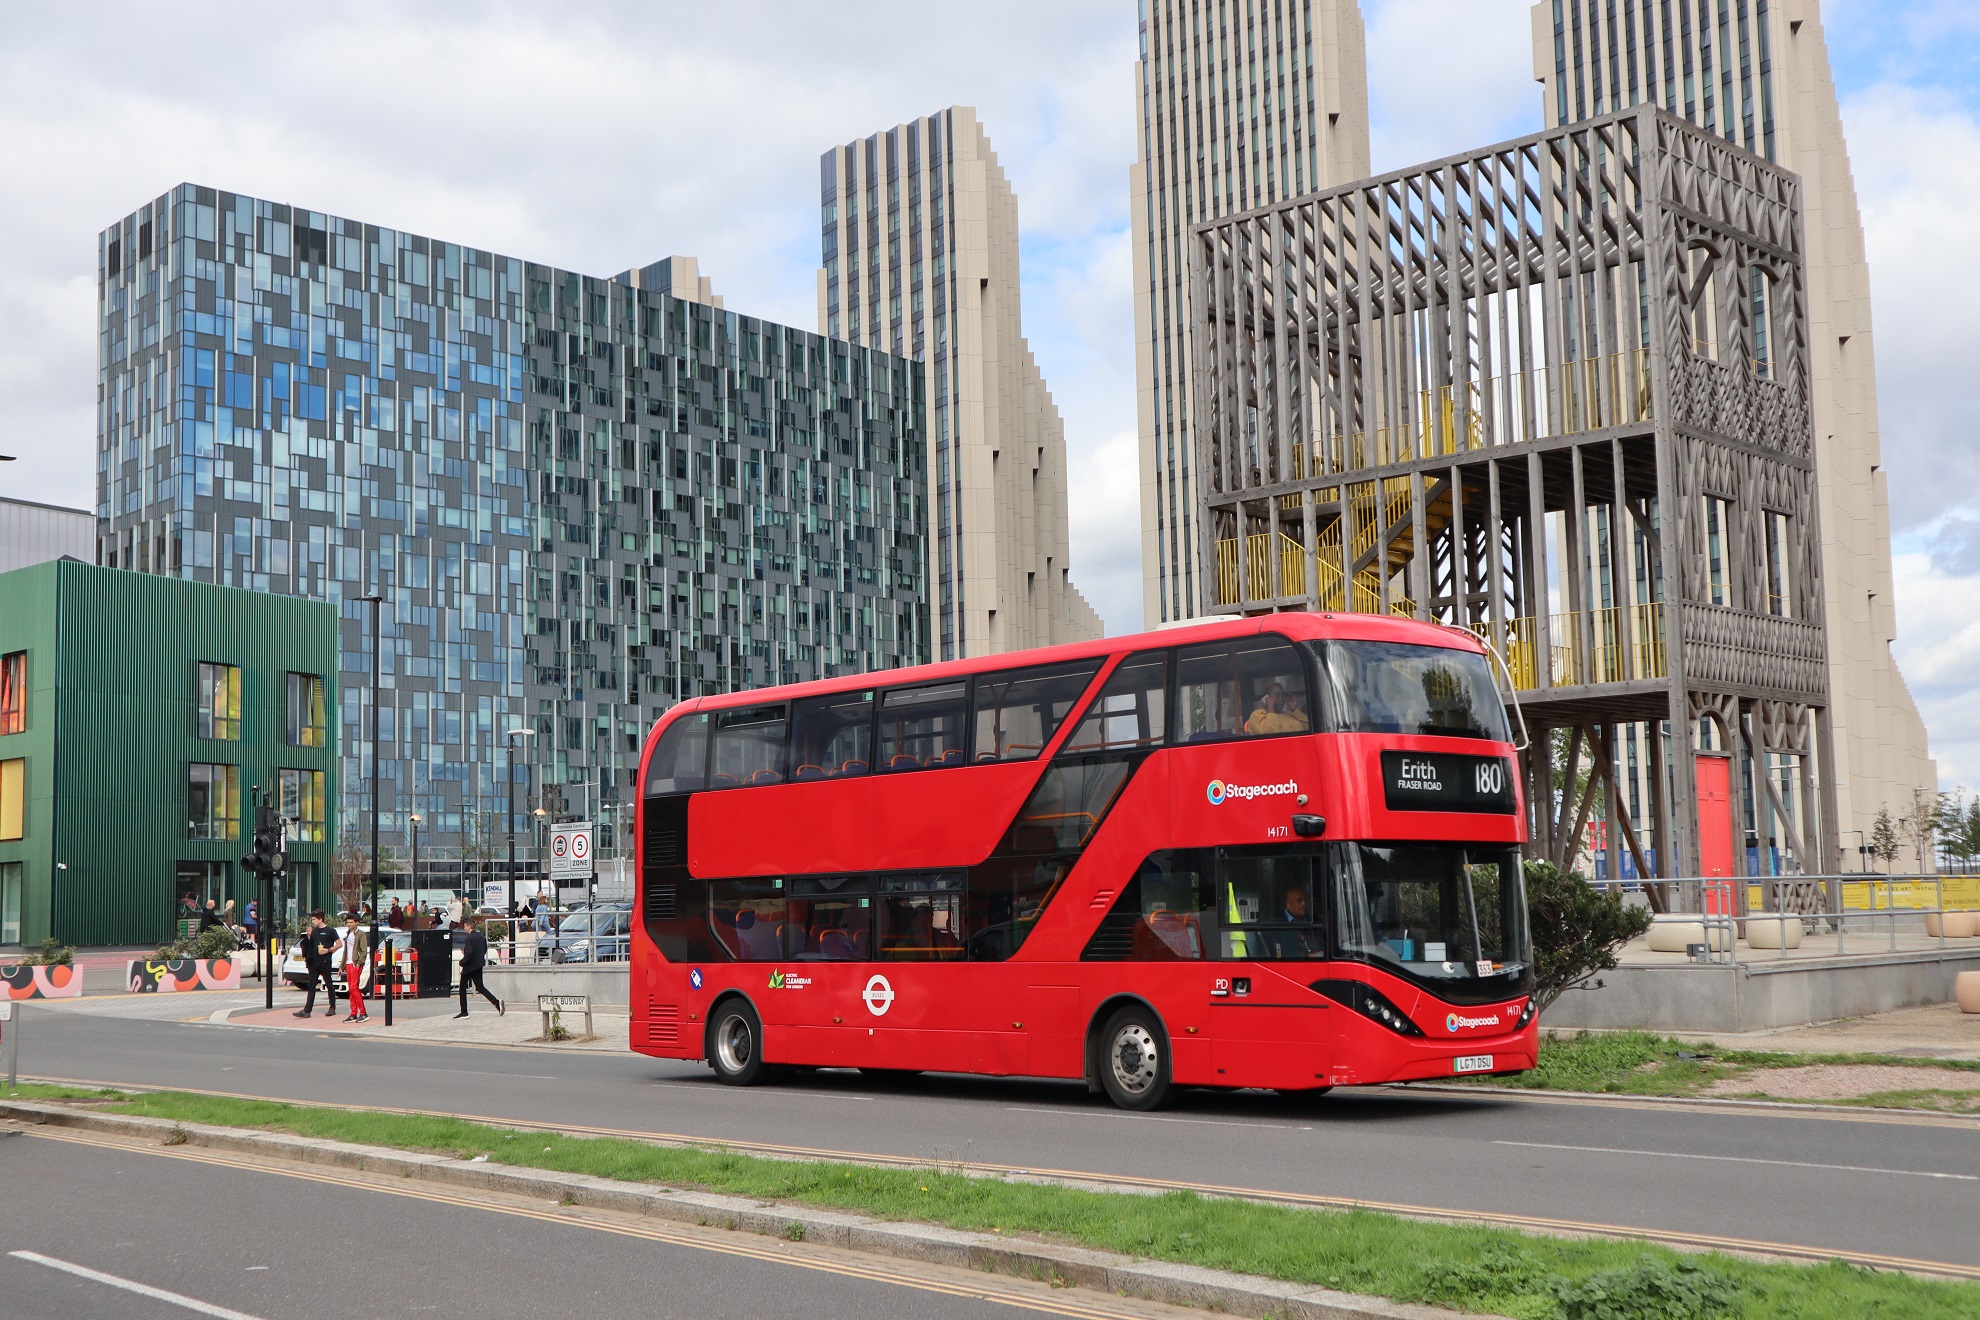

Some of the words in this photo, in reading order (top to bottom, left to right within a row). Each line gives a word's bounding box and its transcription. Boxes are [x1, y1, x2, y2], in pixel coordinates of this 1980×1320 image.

[1402, 758, 1436, 780] Erith
[1475, 763, 1502, 794] 180
[1226, 779, 1298, 800] Stagecoach
[1397, 780, 1422, 791] FRASER
[1423, 782, 1442, 792] ROAD
[1267, 826, 1288, 838] 14171
[577, 841, 583, 851] 5
[1478, 964, 1491, 975] 353
[1216, 978, 1228, 990] PD
[561, 997, 585, 1006] BUSWAY
[1506, 1005, 1521, 1017] 14171
[1458, 1014, 1500, 1029] Stagecoach
[1460, 1058, 1477, 1070] LG71
[1478, 1057, 1491, 1068] DSU
